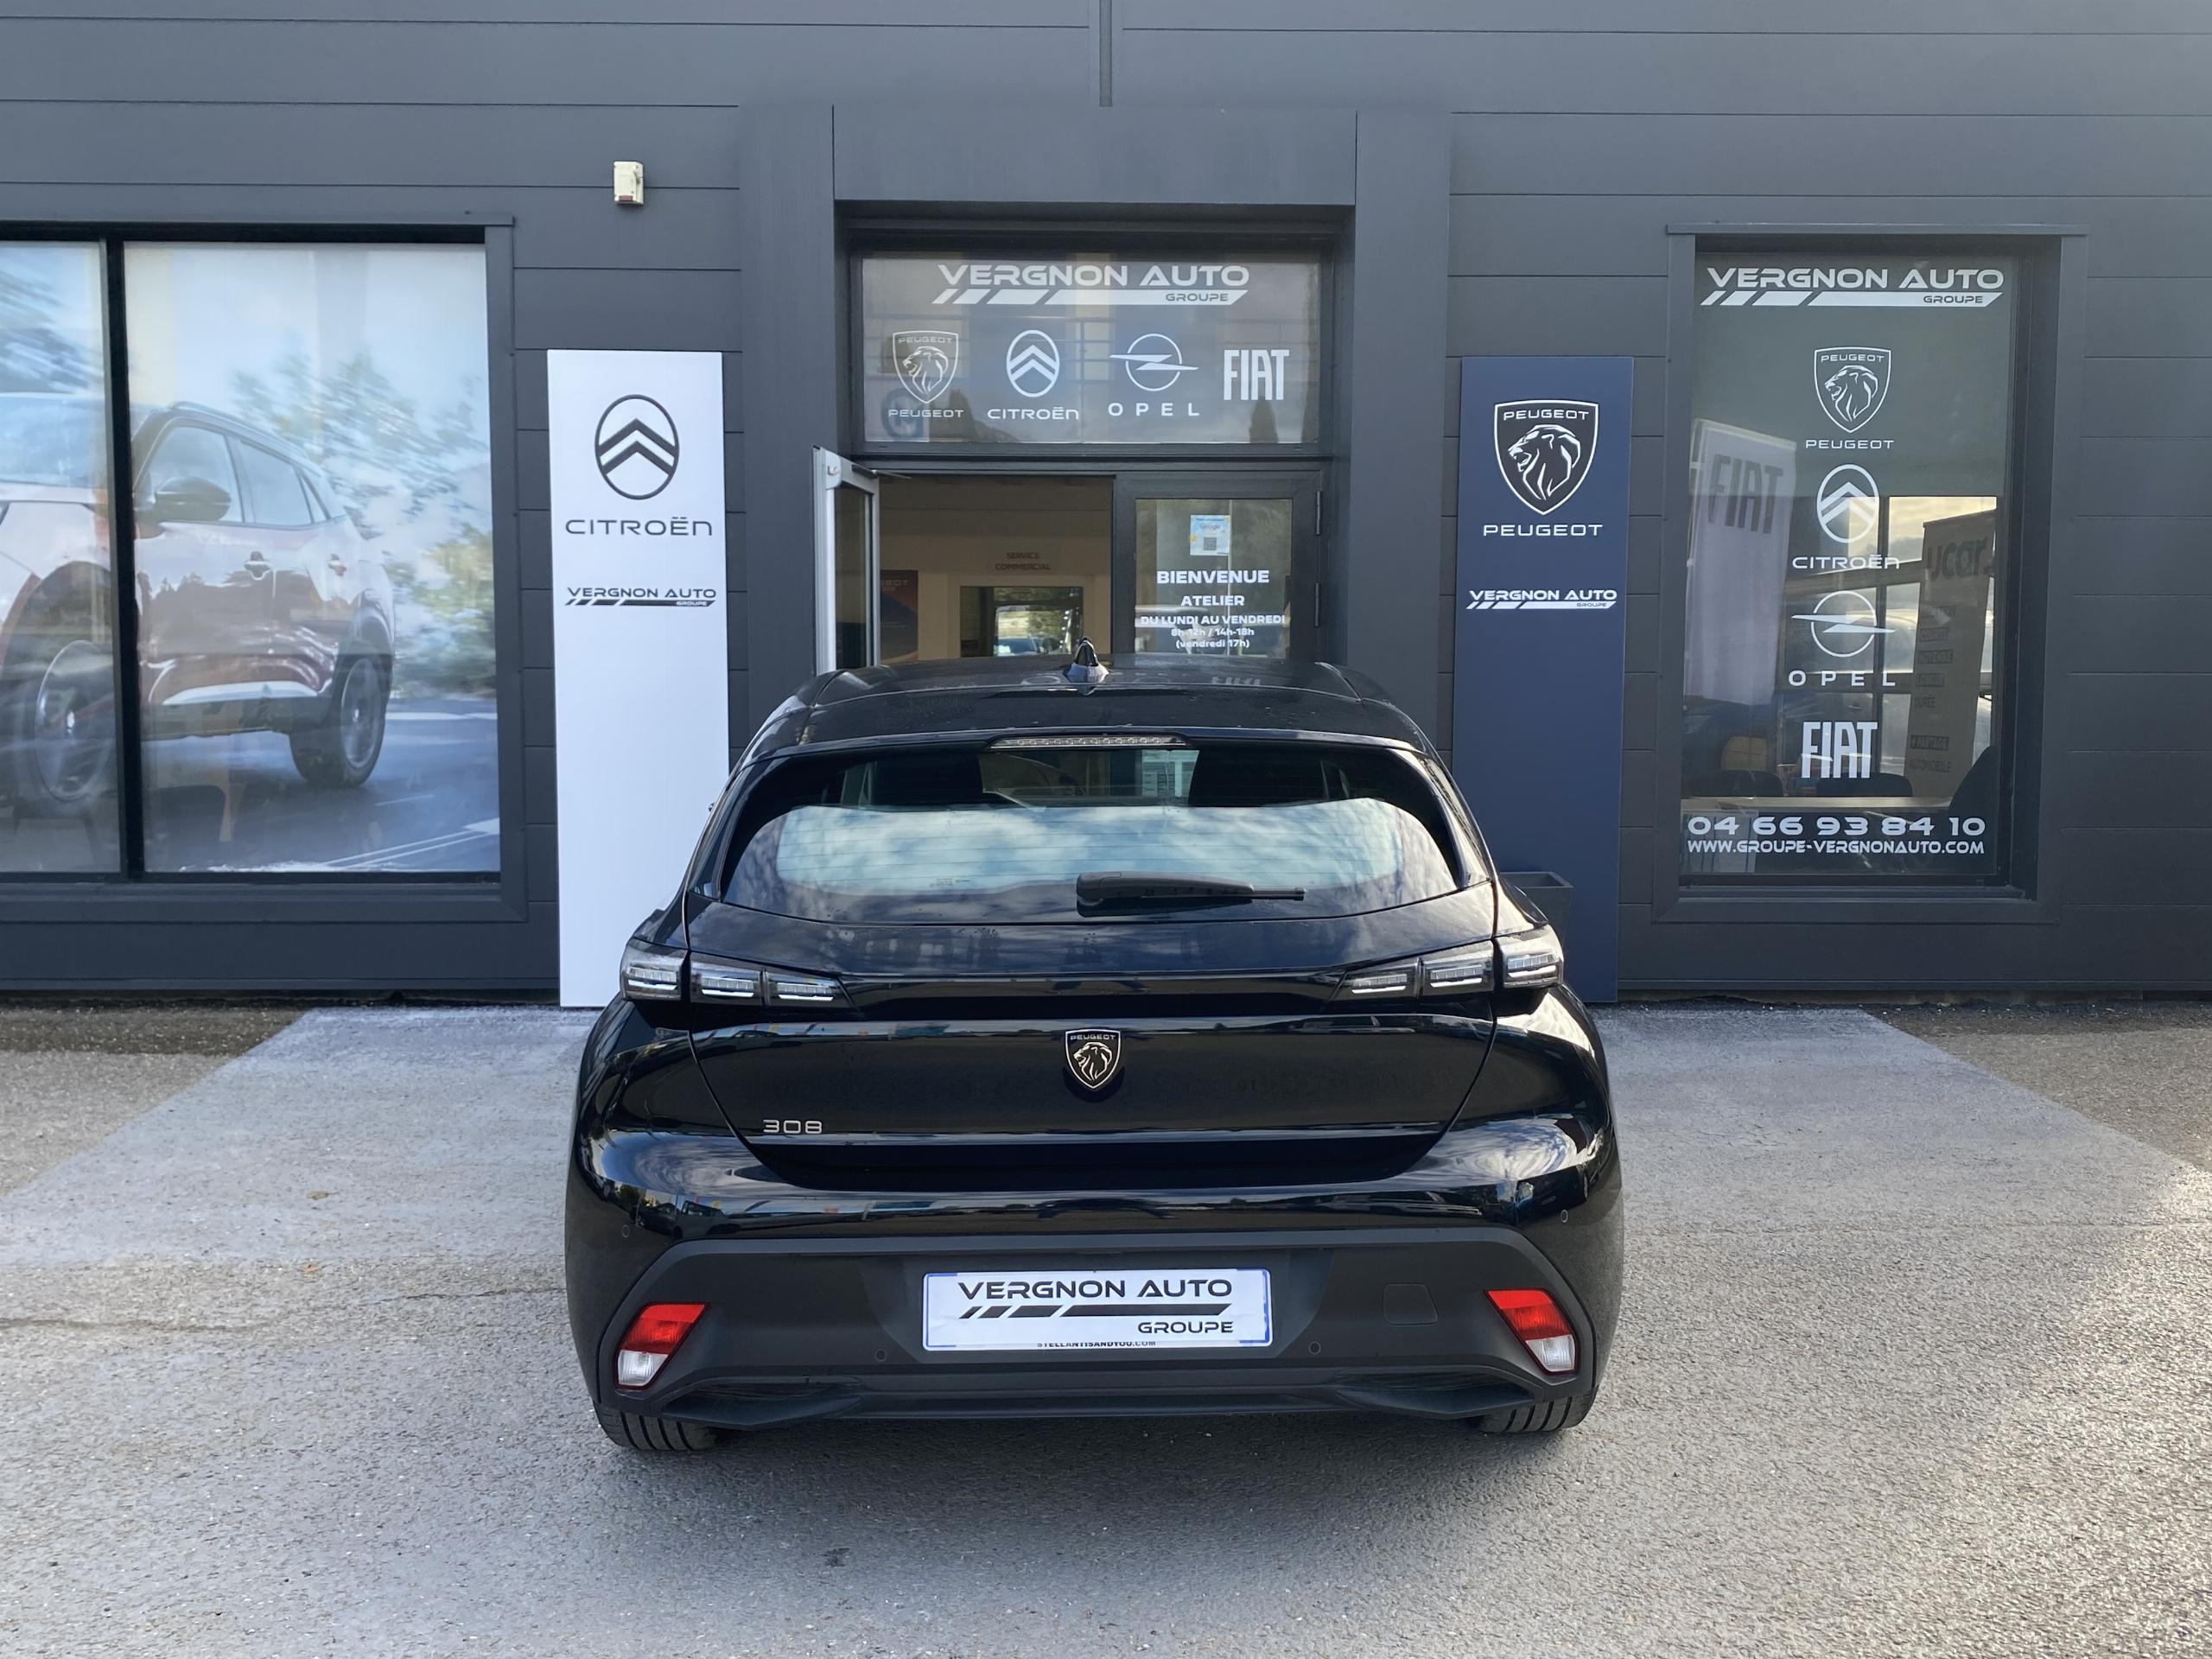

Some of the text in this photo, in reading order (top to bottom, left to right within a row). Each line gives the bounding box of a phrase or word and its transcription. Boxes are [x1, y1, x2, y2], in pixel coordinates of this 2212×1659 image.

[938, 264, 1250, 287] VERGNON AUTO
[1707, 267, 2005, 289] VERGNON AUTO
[1165, 293, 1230, 302] GROUPE
[1923, 295, 1984, 304] GROUPE
[1820, 353, 1885, 364] PEUGEOT
[1223, 349, 1290, 401] FIAT
[888, 409, 964, 418] PEUGEOT
[987, 406, 1079, 421] CITROËN
[1108, 402, 1200, 417] OPEL
[1503, 409, 1590, 421] PEUGEOT
[1805, 439, 1895, 450] PEUGEOT
[1708, 454, 1784, 535] FIAT
[565, 517, 713, 537] CITROËN
[1483, 524, 1603, 537] PEUGEOT
[1006, 551, 1040, 560] SERVICE
[1791, 555, 1900, 570] CITROËN
[995, 563, 1052, 571] COMMERCIAL
[1156, 569, 1270, 584] BIENVENUE
[567, 587, 717, 600] VERGNON AUTO
[1180, 594, 1245, 607] ATELIER
[1469, 589, 1618, 601] VERGNON AUTO
[1140, 614, 1286, 626] DU LUNDI AU VENDREDI
[1215, 627, 1255, 637] 14h-18h
[1227, 639, 1250, 649] 17h)
[1788, 670, 1896, 687] OPEL
[1801, 721, 1878, 779] FIAT
[1687, 817, 1986, 836] 04 66 93 84 10
[1687, 840, 1985, 855] WWW.GROUPE-VERGNONAUTO.COM
[762, 1119, 823, 1135] 308
[958, 1279, 1233, 1300] VERGNON AUTO
[1137, 1320, 1234, 1334] GROUPE
